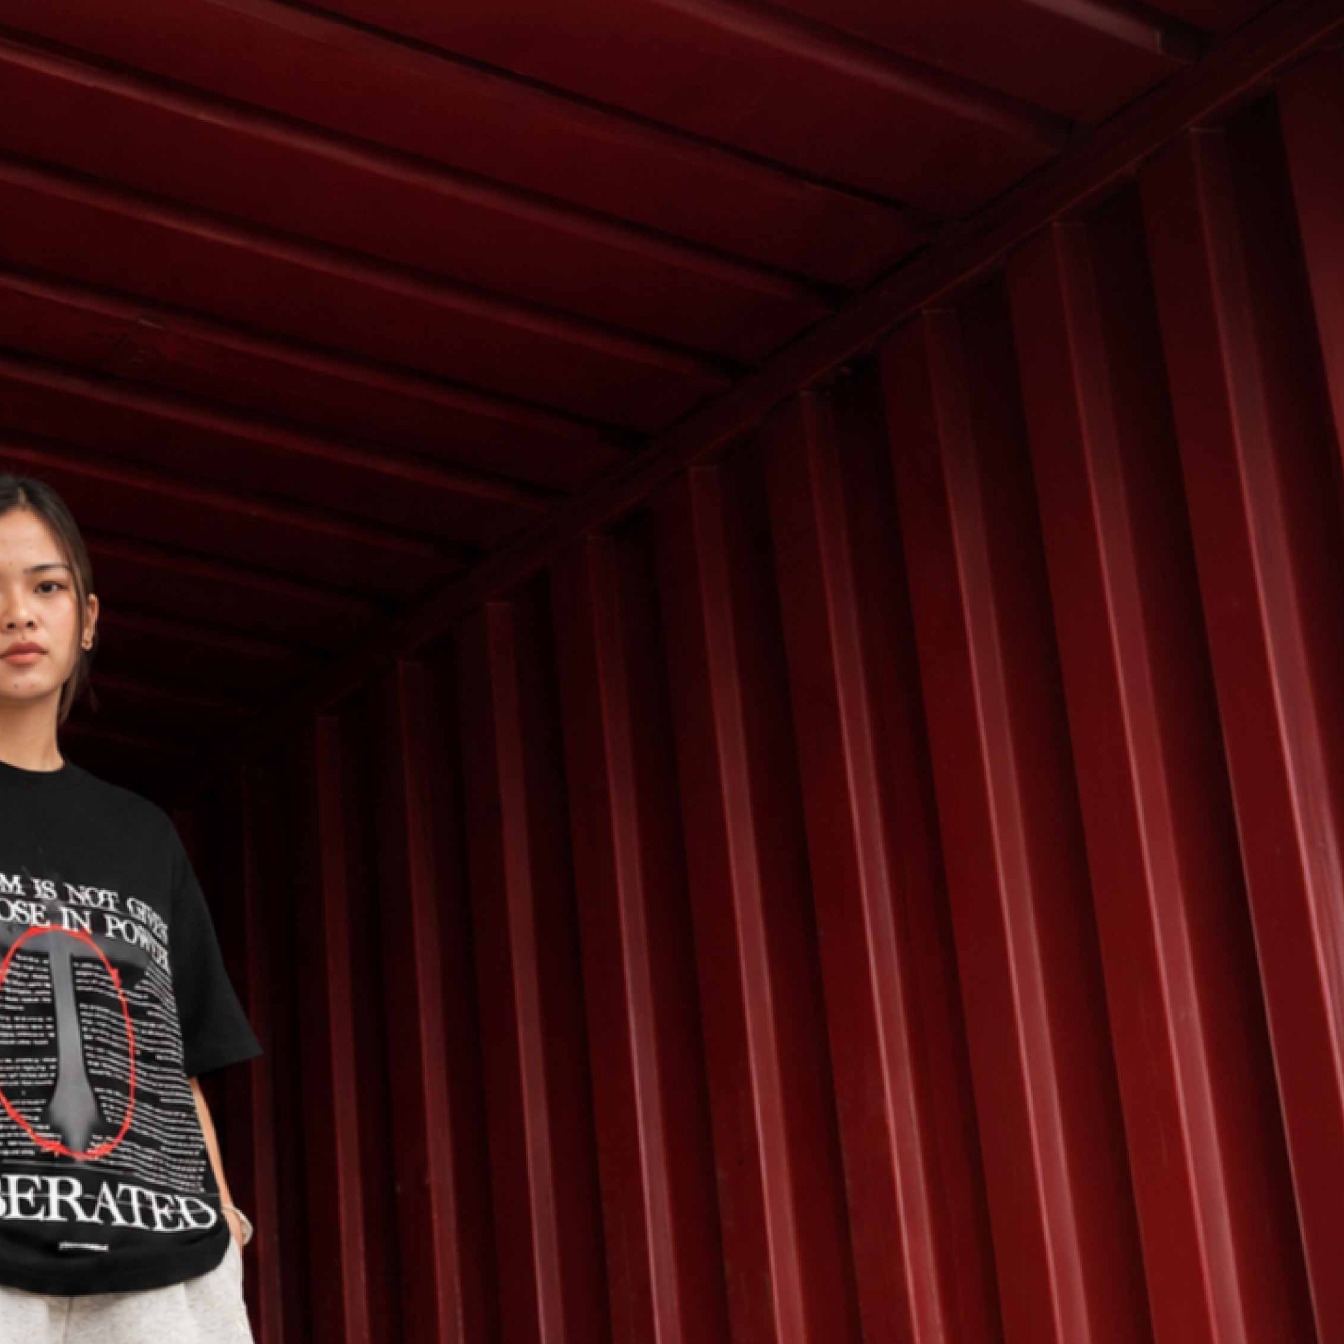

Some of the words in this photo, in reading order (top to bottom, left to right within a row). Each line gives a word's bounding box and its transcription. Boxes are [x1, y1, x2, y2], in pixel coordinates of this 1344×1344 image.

[31, 878, 57, 900] IS
[63, 882, 119, 914] NOT
[60, 905, 92, 936] IN
